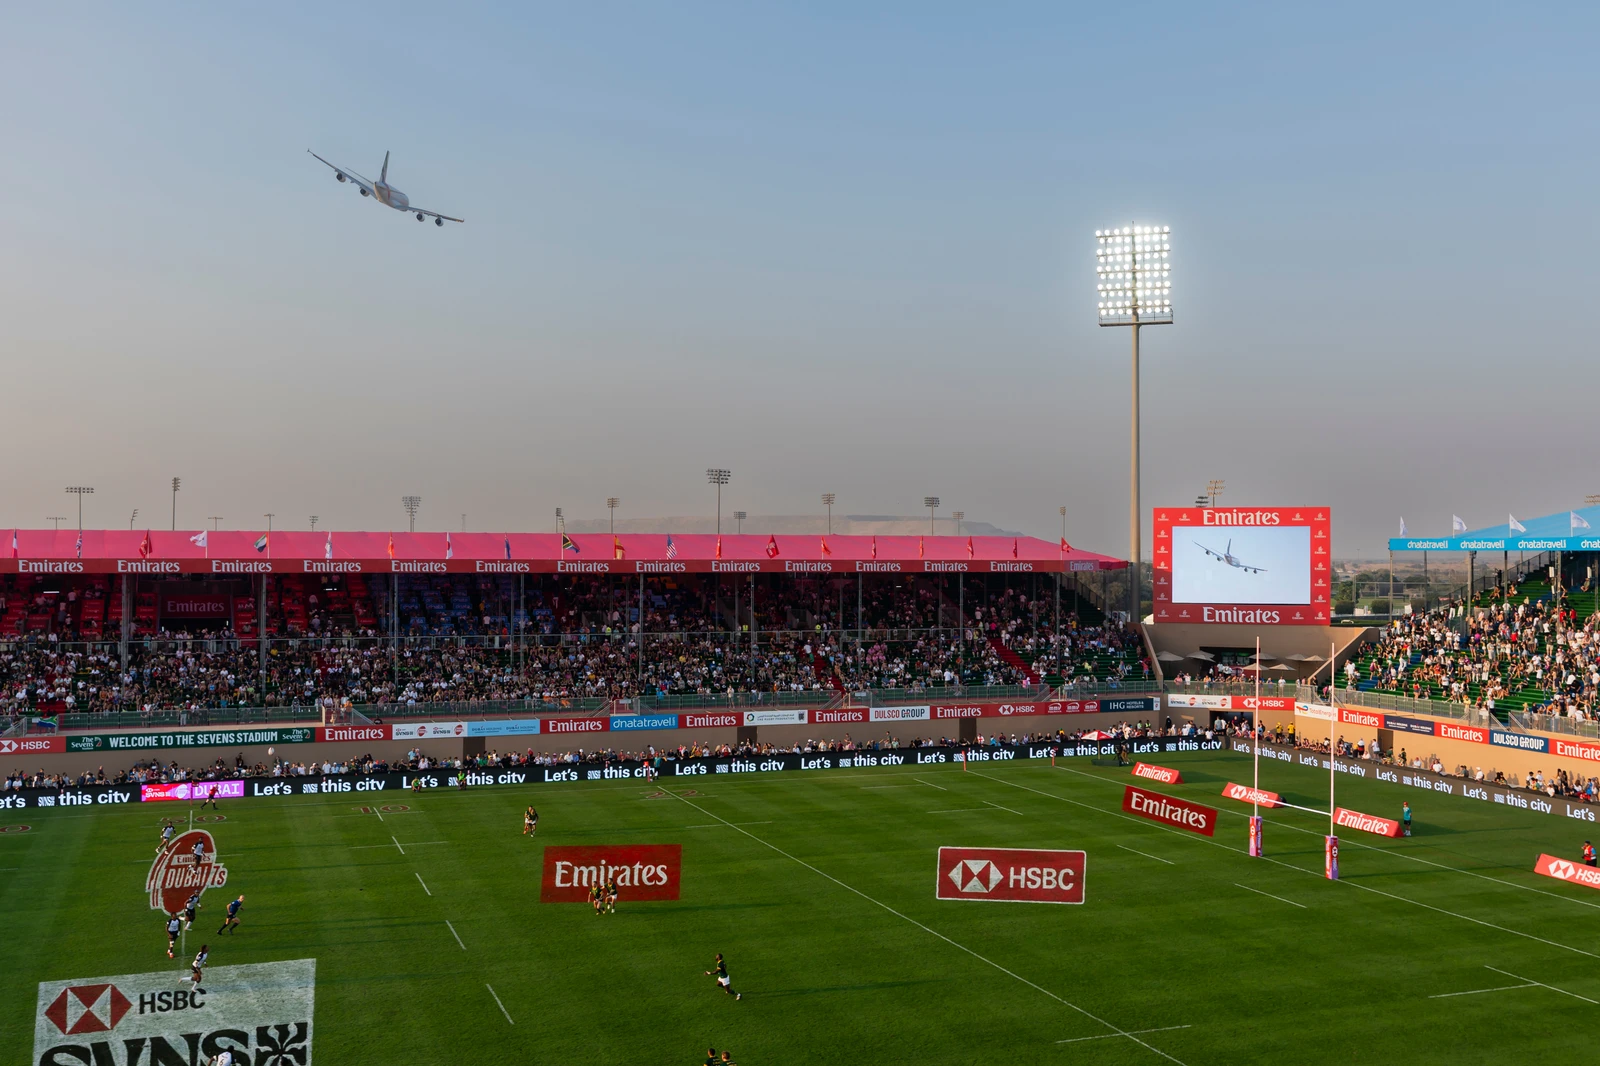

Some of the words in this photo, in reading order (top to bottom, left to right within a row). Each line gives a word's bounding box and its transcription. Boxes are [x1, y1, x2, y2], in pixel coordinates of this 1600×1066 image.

[1203, 508, 1280, 525] Emirates
[18, 560, 83, 573] Emirates
[118, 560, 180, 573] Emirates
[212, 559, 272, 572] Emirates
[303, 560, 361, 572] Emirates
[391, 560, 446, 572] Emirates
[476, 560, 529, 572] Emirates
[557, 560, 609, 572] Emirates
[636, 561, 686, 572] Emirates
[711, 561, 760, 572] Emirates
[785, 561, 832, 572] Emirates
[856, 561, 901, 572] Emirates
[924, 561, 968, 572] Emirates
[990, 561, 1032, 572] Emirates
[1070, 560, 1094, 571] Emirates
[167, 600, 224, 612] Emirates
[1203, 606, 1280, 623] Emirates
[816, 711, 862, 722] Emirates
[875, 709, 899, 719] DULSCO
[902, 709, 925, 718] GROUP
[937, 707, 981, 718] Emirates
[1343, 711, 1379, 726] Emirates
[549, 720, 602, 732] Emirates
[686, 715, 736, 727] Emirates
[109, 736, 158, 747] WELCOME
[160, 736, 173, 745] TO
[175, 735, 195, 745] THE
[197, 733, 235, 744] SEVENS
[237, 731, 278, 742] STADIUM
[325, 728, 384, 740] Emirates
[1441, 725, 1483, 742] Emirates
[21, 741, 50, 750] HSBC
[1134, 742, 1159, 753] Let's
[1178, 740, 1198, 751] this
[1494, 733, 1518, 746] DULSCO
[1520, 738, 1544, 750] GROUP
[918, 752, 946, 764] Let's
[967, 750, 989, 761] this
[1076, 745, 1098, 756] this
[1101, 744, 1115, 754] cit
[1233, 741, 1250, 755] Let's
[1262, 747, 1276, 760] this
[1278, 750, 1292, 764] city
[676, 763, 707, 775] Let's
[731, 760, 756, 772] this
[801, 757, 831, 769] Let's
[854, 755, 877, 766] this
[1300, 756, 1318, 768] Let's
[1333, 761, 1348, 774] this
[1350, 764, 1366, 779] city
[403, 775, 438, 789] Lt's
[466, 772, 494, 786] this
[544, 768, 578, 782] Let's
[603, 766, 630, 779] this
[1136, 764, 1172, 783] Emirates
[254, 782, 292, 796] Let's
[321, 779, 351, 793] this
[1376, 768, 1398, 783] Let's
[1413, 776, 1432, 790] this
[1434, 780, 1452, 794] city
[58, 791, 92, 806] this
[1463, 785, 1488, 801] Let's
[1506, 793, 1527, 809] this
[1531, 798, 1552, 814] city
[1131, 792, 1206, 829] Emirates
[1567, 804, 1595, 822] Let's
[1337, 809, 1389, 834] Emirates
[165, 867, 208, 889] DUBAI
[210, 866, 226, 888] 7s
[556, 859, 667, 888] Emirates
[1009, 866, 1074, 891] HSBC
[139, 988, 207, 1014] HSBC
